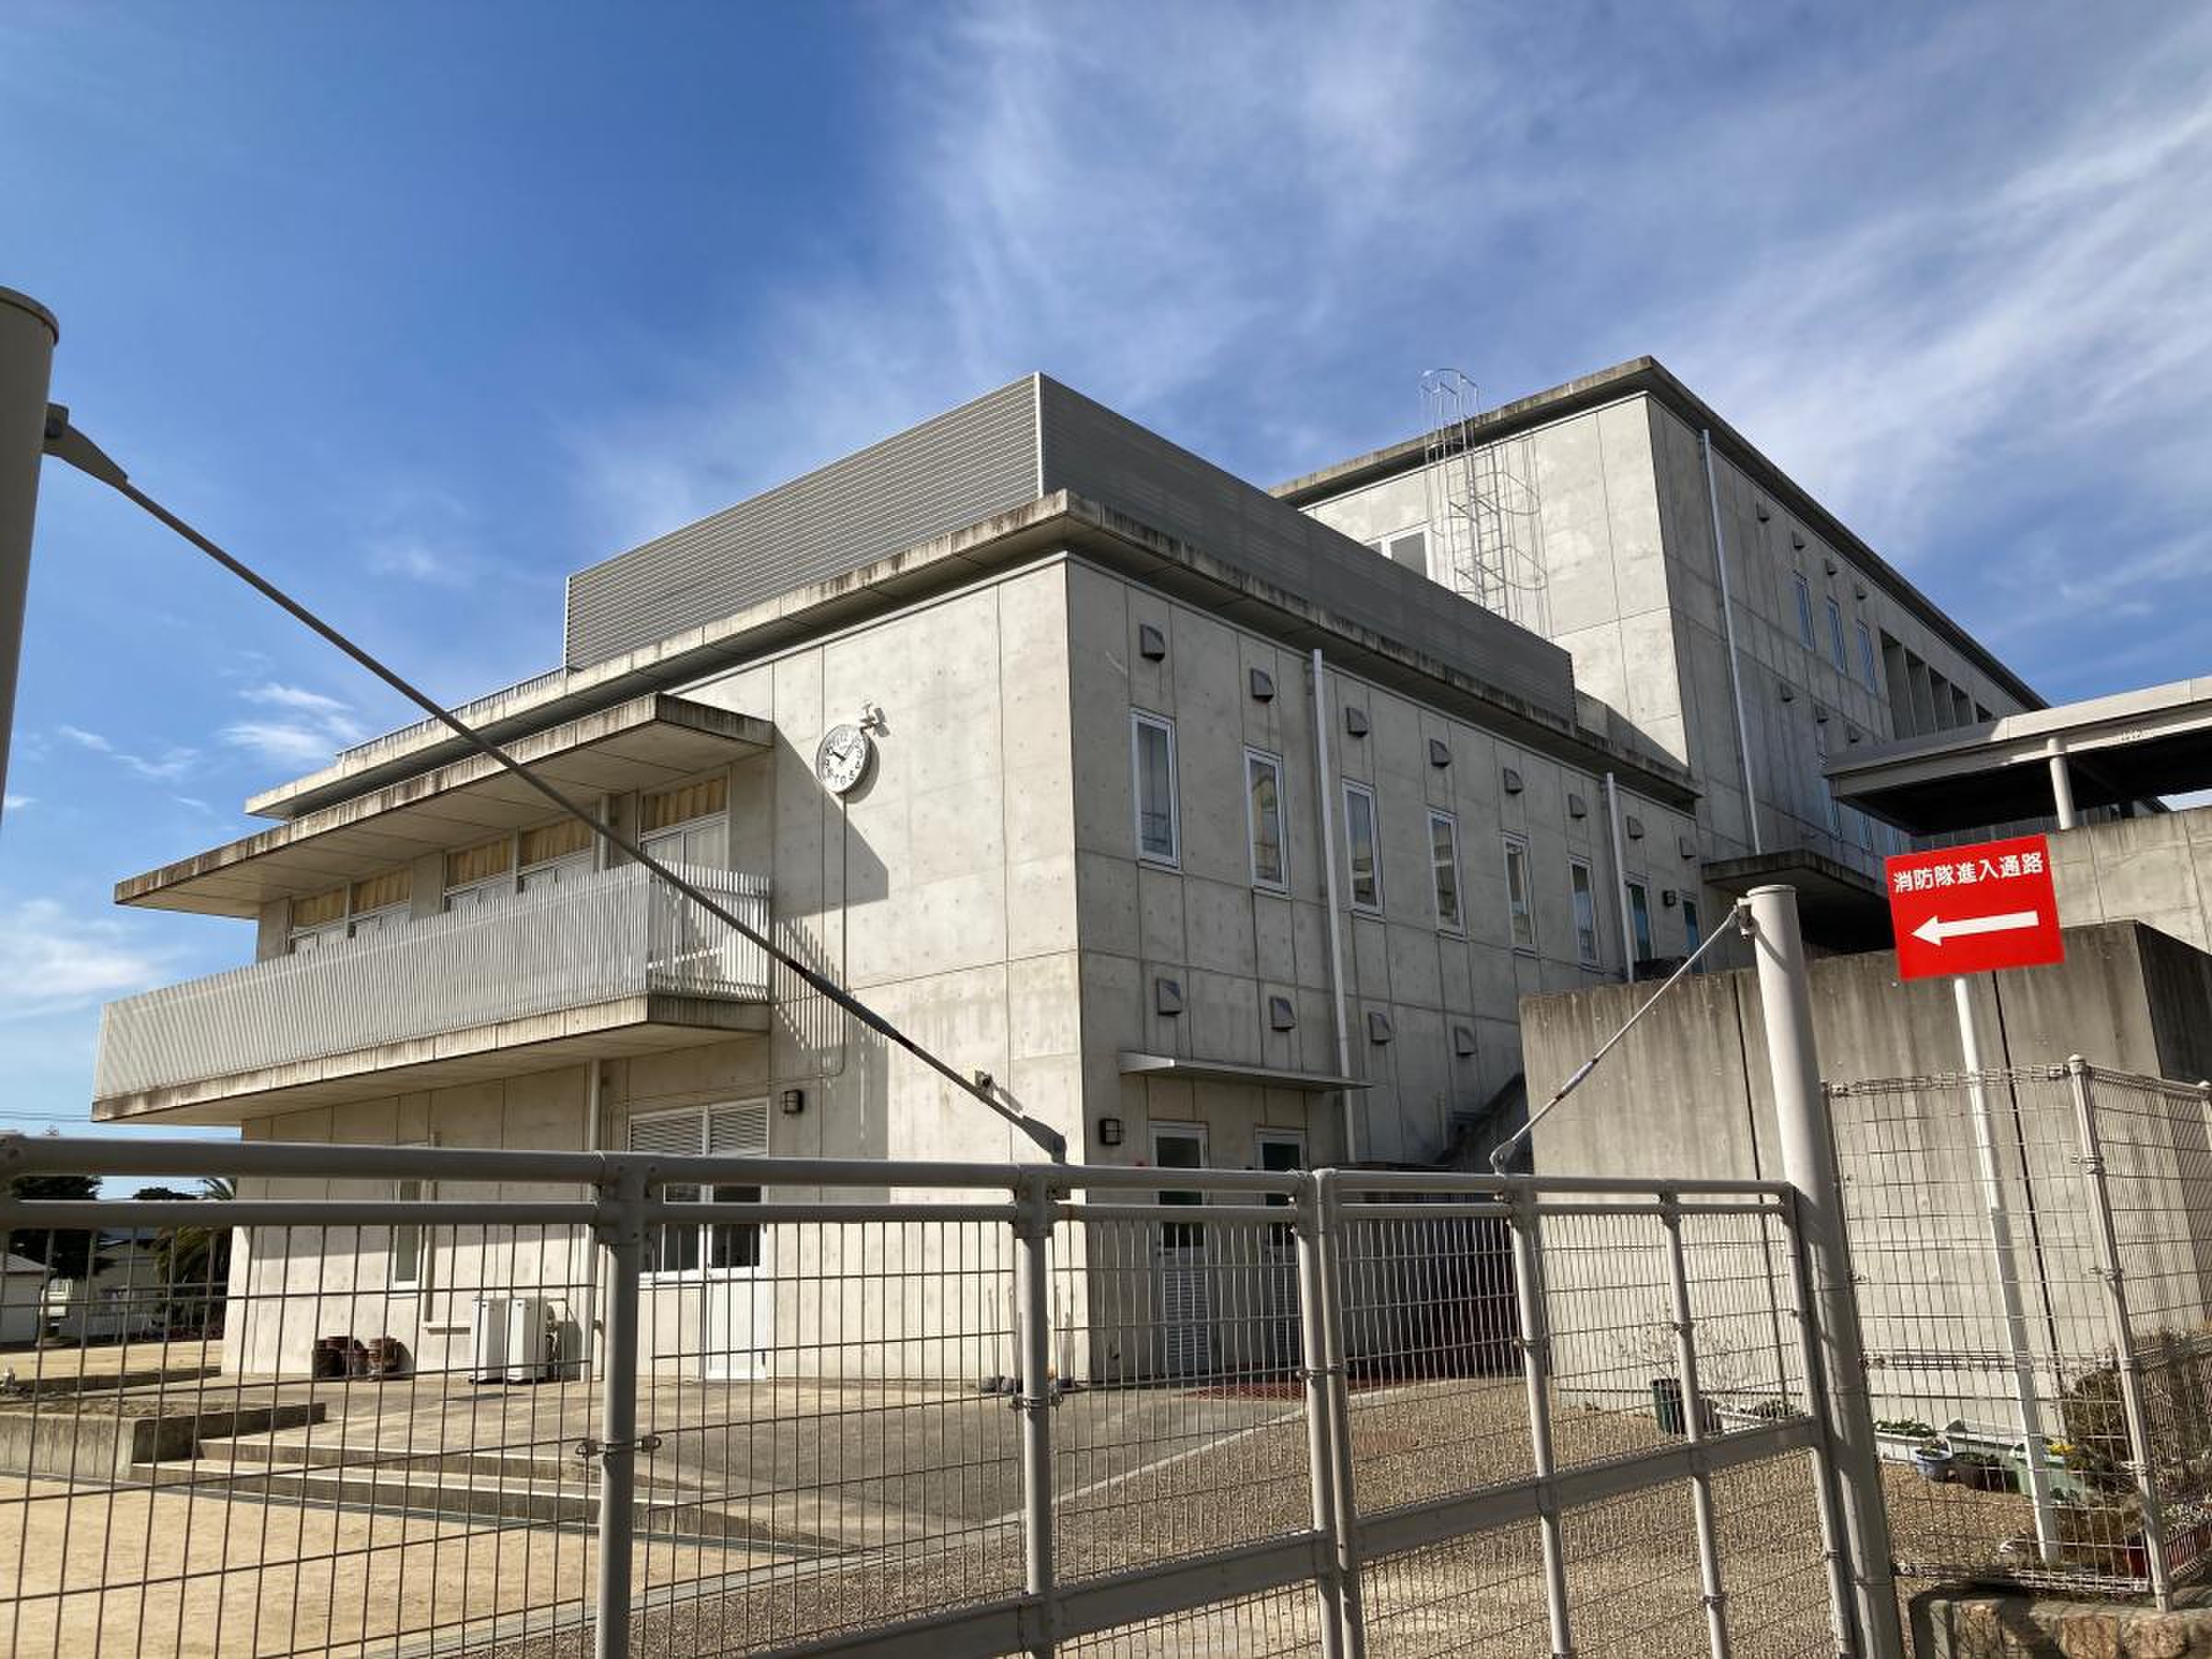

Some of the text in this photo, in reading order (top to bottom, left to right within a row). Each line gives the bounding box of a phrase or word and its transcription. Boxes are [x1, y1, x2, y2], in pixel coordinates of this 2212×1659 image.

[1893, 852, 2043, 893] 消防隊進入通路
